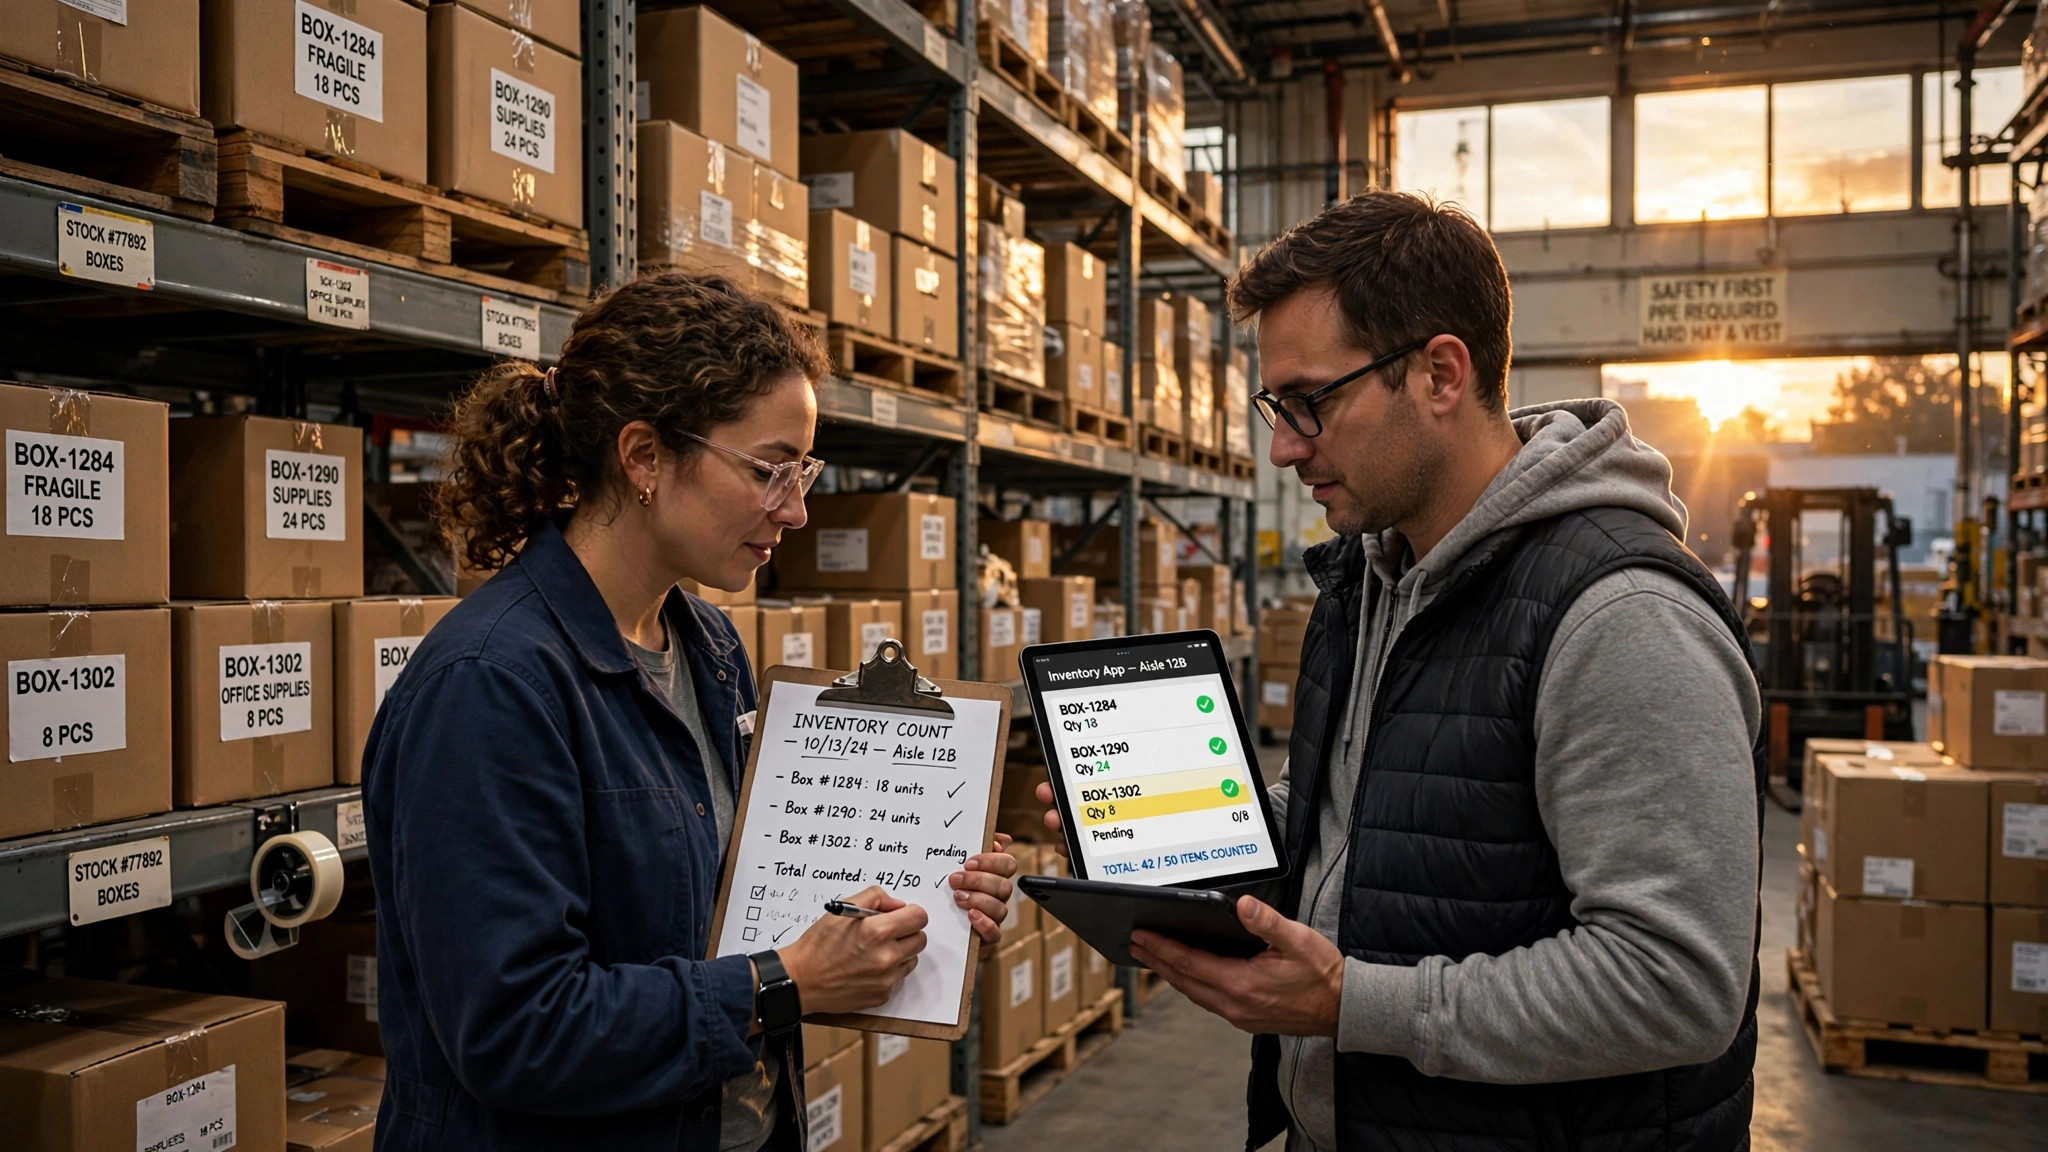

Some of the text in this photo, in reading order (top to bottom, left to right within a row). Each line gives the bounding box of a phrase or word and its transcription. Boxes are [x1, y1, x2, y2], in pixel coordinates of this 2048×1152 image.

[302, 12, 375, 60] BOX-1284
[308, 44, 366, 82] FRAGILE
[314, 73, 360, 105] 18 PCS
[496, 80, 550, 119] BOX-1290
[496, 104, 546, 139] SUPPLIES
[504, 130, 539, 159] 24 PCS
[66, 220, 146, 251] STOCK #77892
[86, 250, 124, 272] BOXES
[1651, 277, 1774, 300] SAFETY FIRST
[1742, 322, 1782, 341] VEST
[15, 442, 114, 473] BOX-1284
[271, 460, 339, 484] BOX-1290
[24, 474, 101, 500] FRAGILE
[273, 486, 332, 507] SUPPLIES
[32, 504, 93, 528] 18 PCS
[283, 512, 325, 530] 24 PCS
[225, 653, 302, 678] BOX-1302
[1048, 667, 1100, 682] Inventory
[1103, 665, 1125, 678] App
[1140, 659, 1165, 672] Aisle
[1166, 657, 1187, 669] 12B
[17, 666, 115, 694] BOX-1302
[222, 680, 310, 704] OFFICE SUPPLIES
[247, 707, 283, 728] 8 PCS
[1059, 699, 1117, 715] BOX-1284
[43, 722, 93, 747] 8 PCS
[792, 713, 953, 739] INVENTORY COUNT
[1063, 717, 1098, 732] Qty 18
[804, 735, 868, 756] 10/13/24
[892, 744, 925, 760] Aisle
[932, 747, 957, 762] 12B
[1070, 741, 1129, 758] BOX-1290
[1075, 760, 1110, 776] Qty 24
[791, 771, 813, 786] Box
[876, 779, 889, 792] 18
[894, 783, 924, 796] units
[1082, 784, 1142, 802] BOX-1302
[785, 800, 808, 815] Box
[869, 809, 886, 821] 24
[891, 812, 921, 825] units
[1087, 805, 1116, 819] Qty 8
[1092, 810, 1249, 842] Pending 0/8
[779, 829, 802, 845] Box
[864, 838, 874, 851] 8
[879, 842, 908, 854] units
[925, 843, 968, 864] pending
[75, 850, 162, 882] STOCK #77892
[1103, 863, 1139, 876] TOTAL:
[1141, 858, 1155, 870] 42
[1164, 855, 1178, 867] 50
[1180, 850, 1209, 864] ITEMS
[1211, 843, 1258, 859] COUNTED
[774, 862, 807, 877] Total
[812, 868, 866, 882] counted:
[876, 870, 921, 890] 42/50
[98, 882, 139, 906] BOXES
[209, 1118, 224, 1133] PCS
